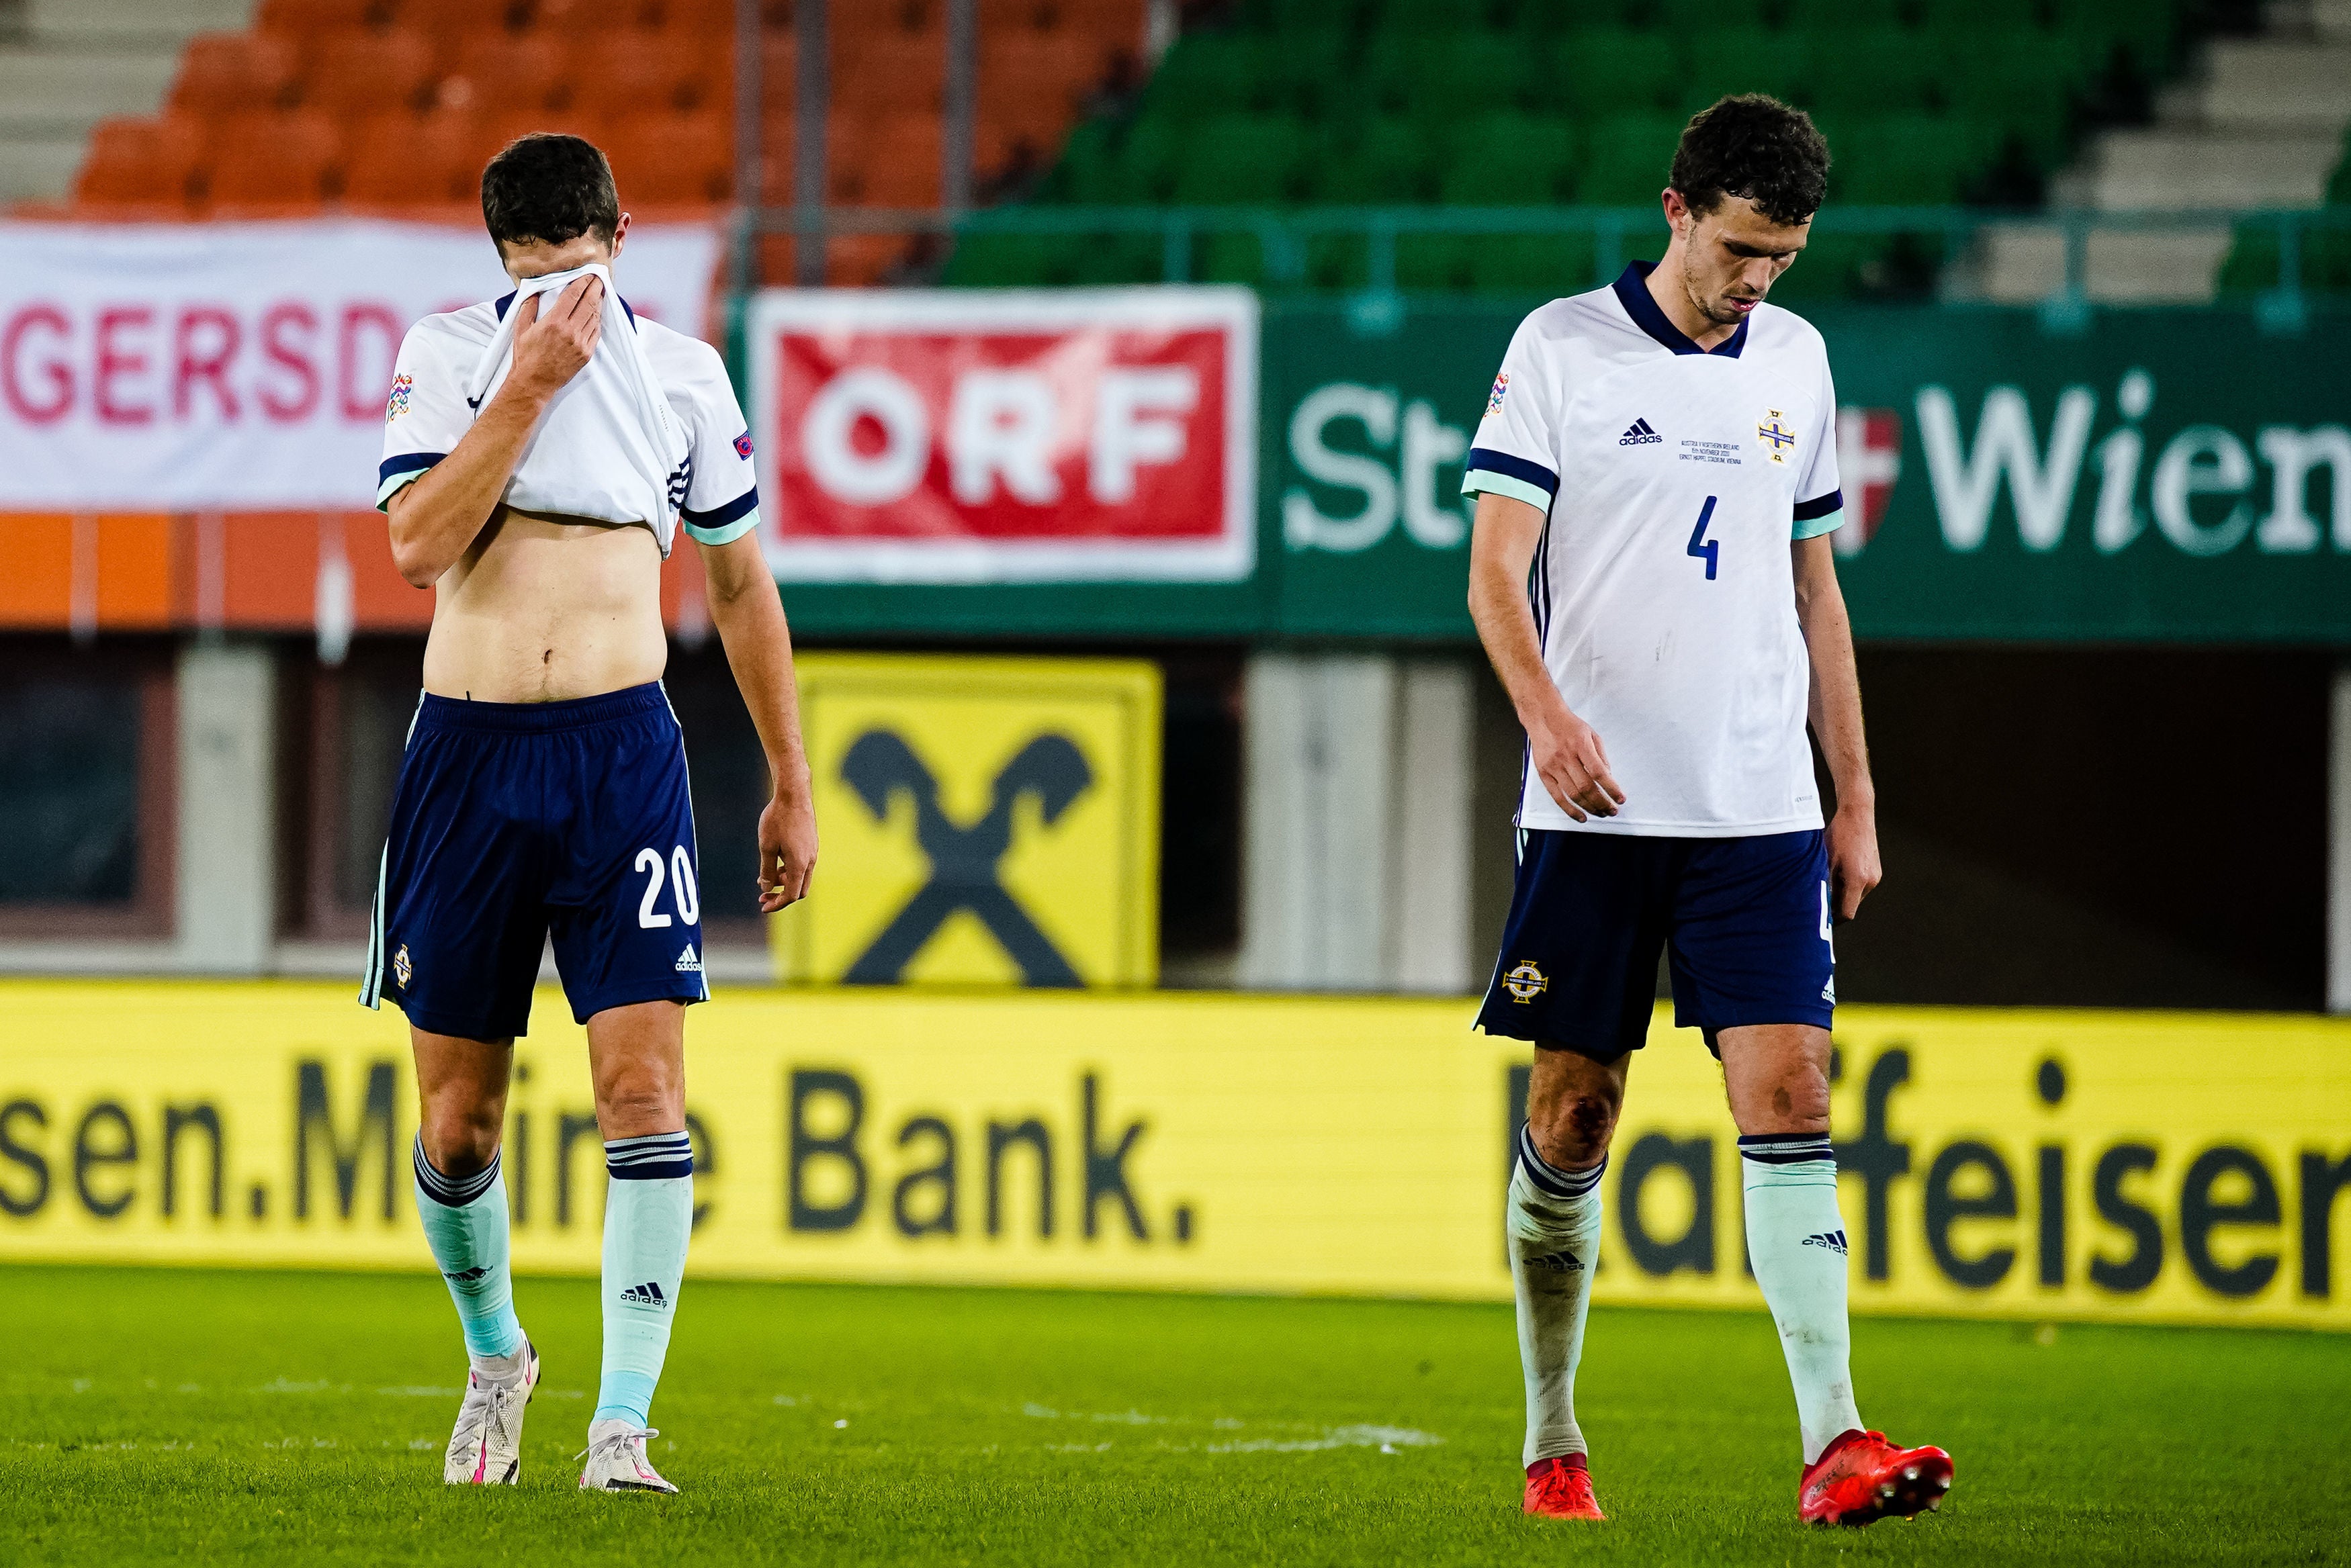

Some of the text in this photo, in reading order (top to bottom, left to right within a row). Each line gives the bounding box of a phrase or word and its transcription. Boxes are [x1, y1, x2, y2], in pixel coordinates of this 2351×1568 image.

[1, 298, 662, 427] GERSD
[806, 367, 1199, 505] ORF
[1286, 367, 2351, 554] St Wien
[1619, 434, 1662, 446] adidas
[1687, 496, 1718, 580] 4
[635, 845, 699, 929] 20
[675, 960, 702, 972] adidas
[786, 1066, 1196, 1242] Bank.
[1507, 1046, 2351, 1297] afeise
[1802, 1239, 1848, 1256] adida
[620, 1293, 667, 1309] adidas
